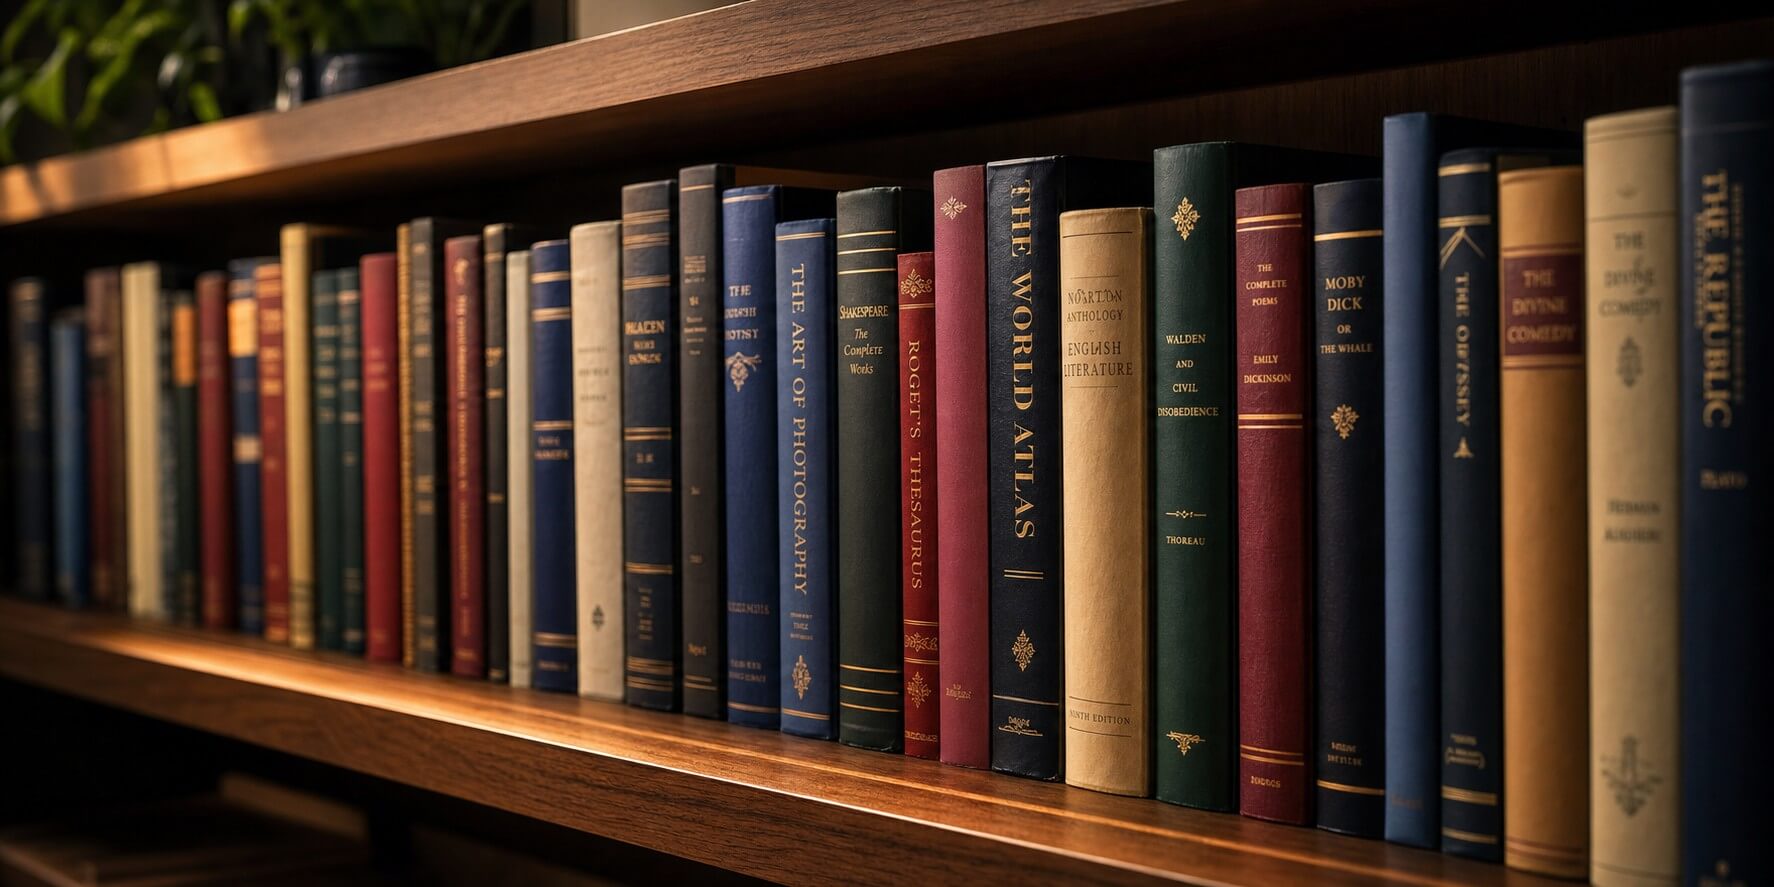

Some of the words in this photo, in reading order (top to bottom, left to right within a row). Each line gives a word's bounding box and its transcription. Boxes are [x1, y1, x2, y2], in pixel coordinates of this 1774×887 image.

[1702, 169, 1730, 240] THE
[1010, 179, 1032, 258] THE
[1257, 264, 1272, 273] THE
[1246, 280, 1287, 290] COMPLETE
[1325, 276, 1365, 290] MOBY
[1522, 269, 1555, 289] THE
[791, 263, 804, 314] THE
[1454, 272, 1471, 317] THE
[1252, 297, 1278, 306] POEMS
[1327, 297, 1363, 312] DICK
[839, 304, 889, 320] SHAKESPEARE
[1066, 308, 1123, 323] ANTHOLOGY
[853, 328, 869, 339] The
[1337, 324, 1351, 334] OR
[791, 321, 806, 369] ART
[1012, 271, 1034, 412] WORLD
[1165, 333, 1206, 345] WALDEN
[1702, 253, 1733, 428] REPUBLIC
[1068, 341, 1121, 356] ENGLISH
[1320, 344, 1336, 354] THE
[1338, 343, 1374, 353] WHALE
[1175, 360, 1194, 369] AND
[1253, 355, 1279, 364] EMILY
[1063, 362, 1134, 378] LITERATURE
[1244, 374, 1292, 384] DICKINSON
[792, 377, 806, 409] OF
[908, 340, 921, 439] ROGET'S
[1172, 383, 1199, 393] CIVIL
[1157, 407, 1220, 417] DISOBEDIENCE
[1013, 422, 1035, 539] ATLAS
[792, 417, 807, 595] PHOTOGRAPHY
[909, 451, 923, 590] THESAURUS
[1166, 535, 1206, 546] THOREAU
[1092, 713, 1131, 725] EDITION
